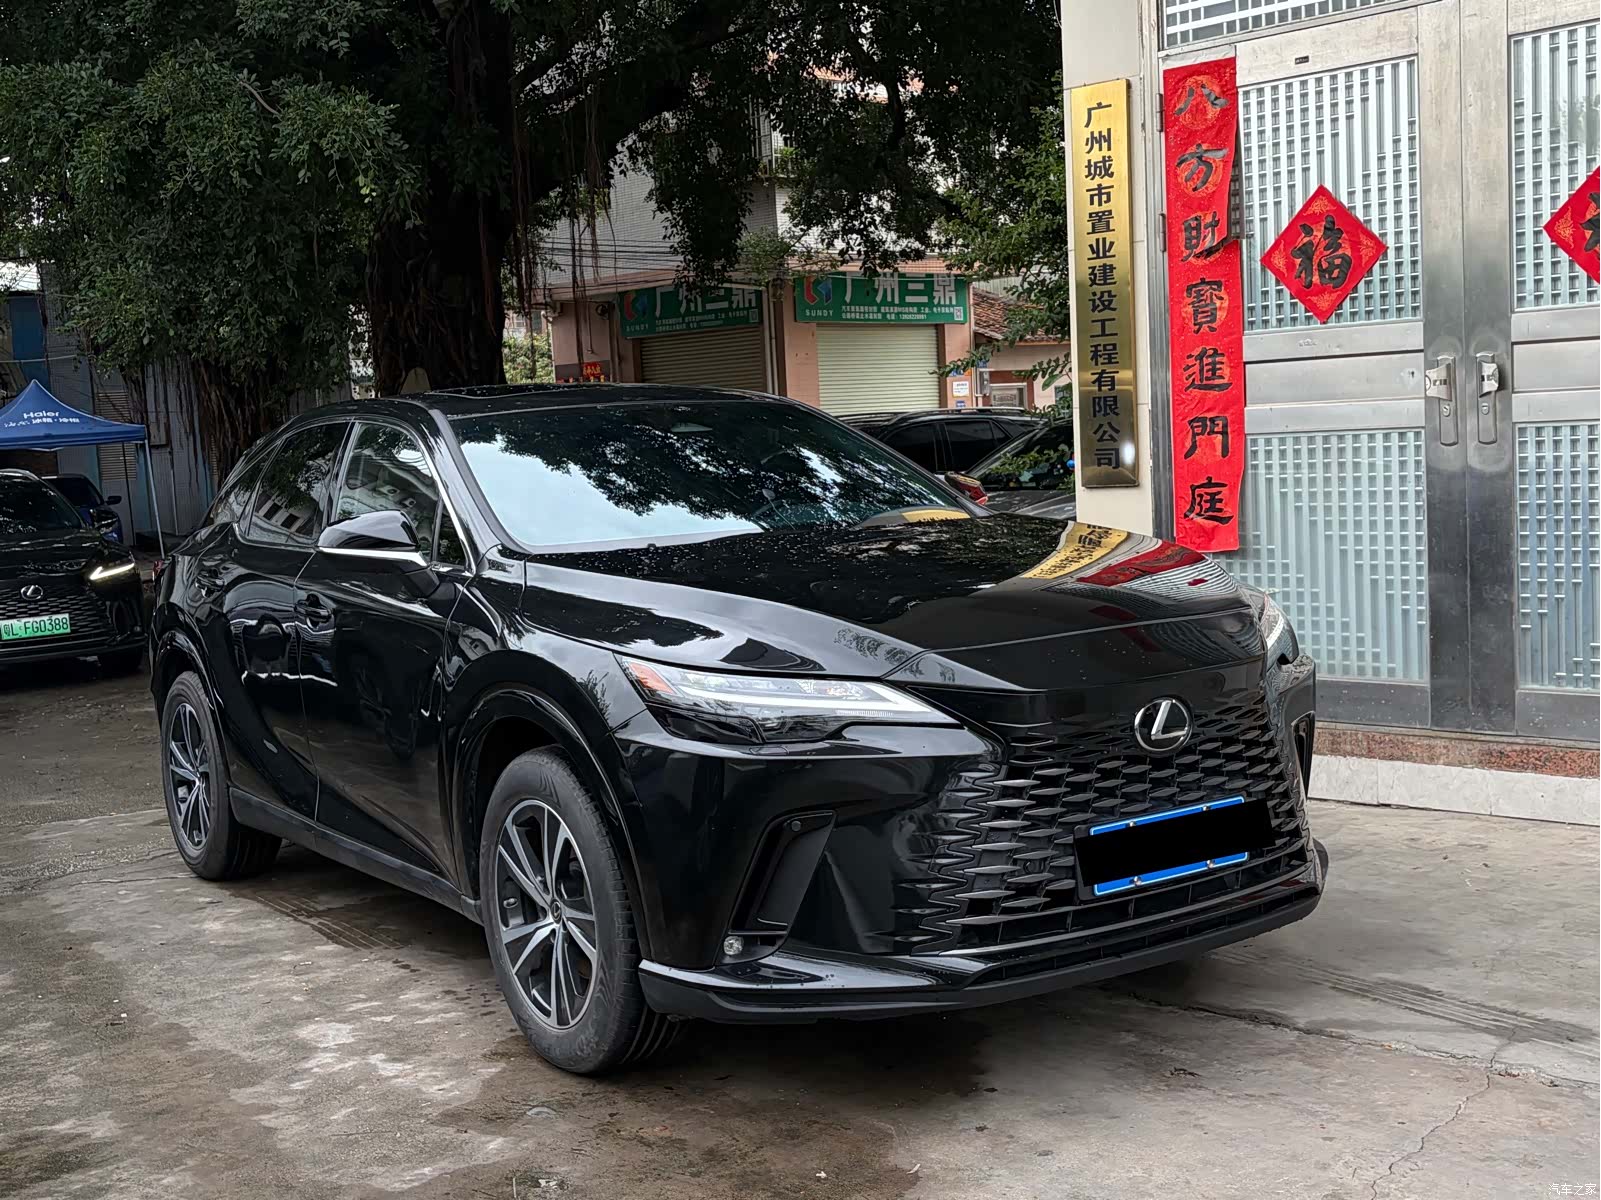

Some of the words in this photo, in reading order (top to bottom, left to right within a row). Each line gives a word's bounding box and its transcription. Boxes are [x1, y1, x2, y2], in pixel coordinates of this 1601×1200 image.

[1290, 214, 1353, 290] 福
[844, 272, 957, 305] 广州三鼎
[1084, 101, 1121, 470] 广州城市置业建设工程有限公司
[1174, 83, 1235, 525] 八方財寶進門庭
[805, 309, 834, 317] SUNDY
[23, 410, 60, 419] Haier
